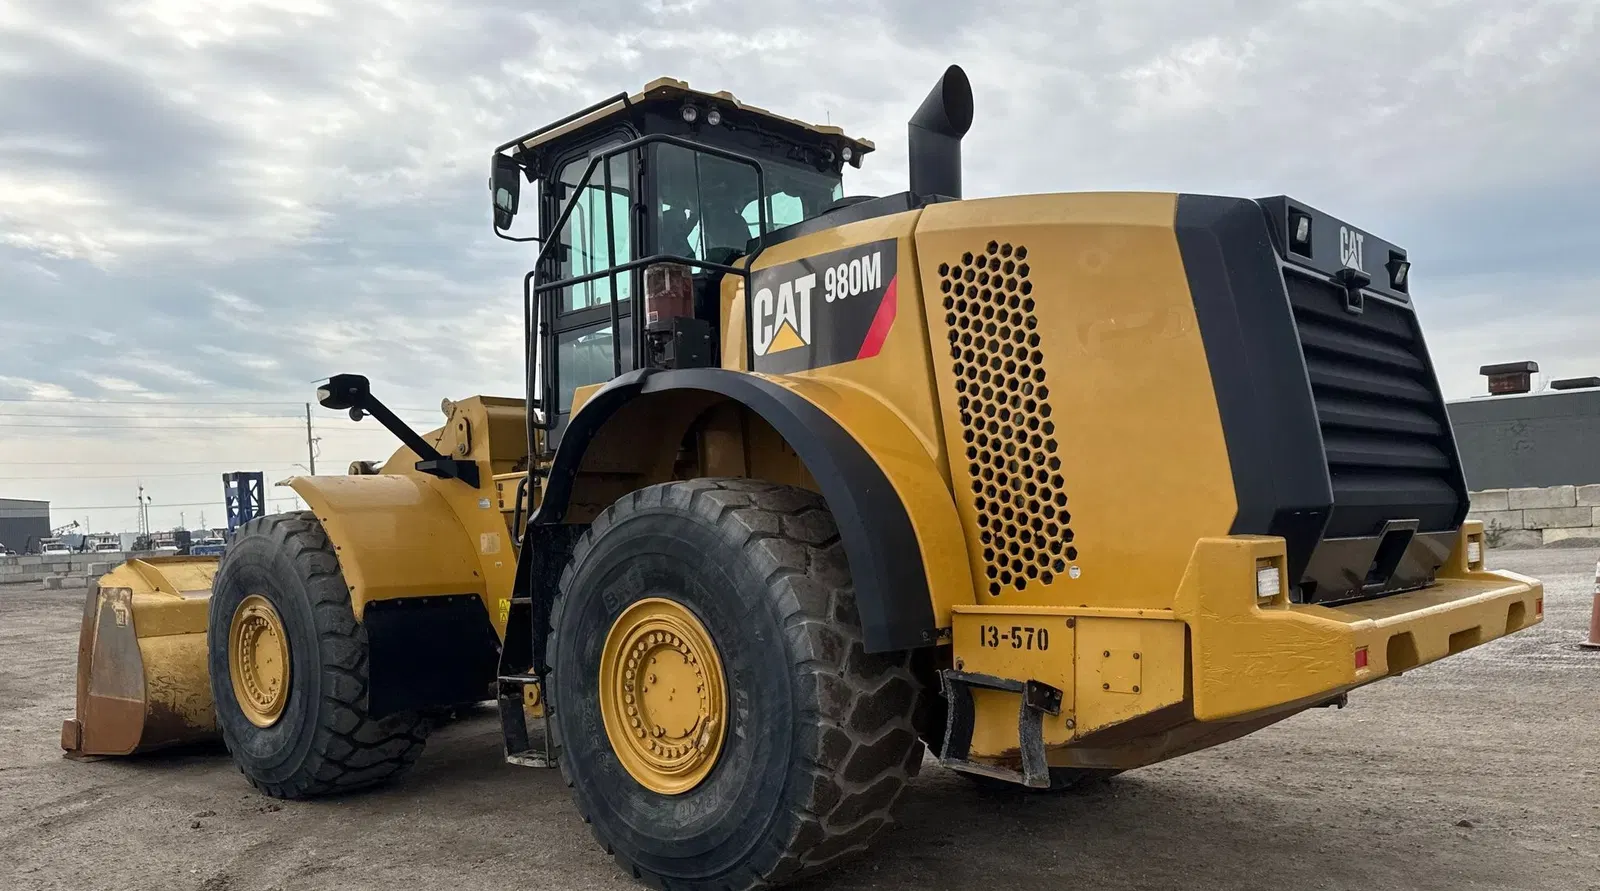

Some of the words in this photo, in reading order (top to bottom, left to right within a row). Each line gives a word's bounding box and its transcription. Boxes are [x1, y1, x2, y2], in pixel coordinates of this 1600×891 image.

[1340, 226, 1363, 271] CAT
[753, 273, 816, 356] CAT
[824, 251, 882, 303] 980M
[980, 624, 1049, 651] 13-570
